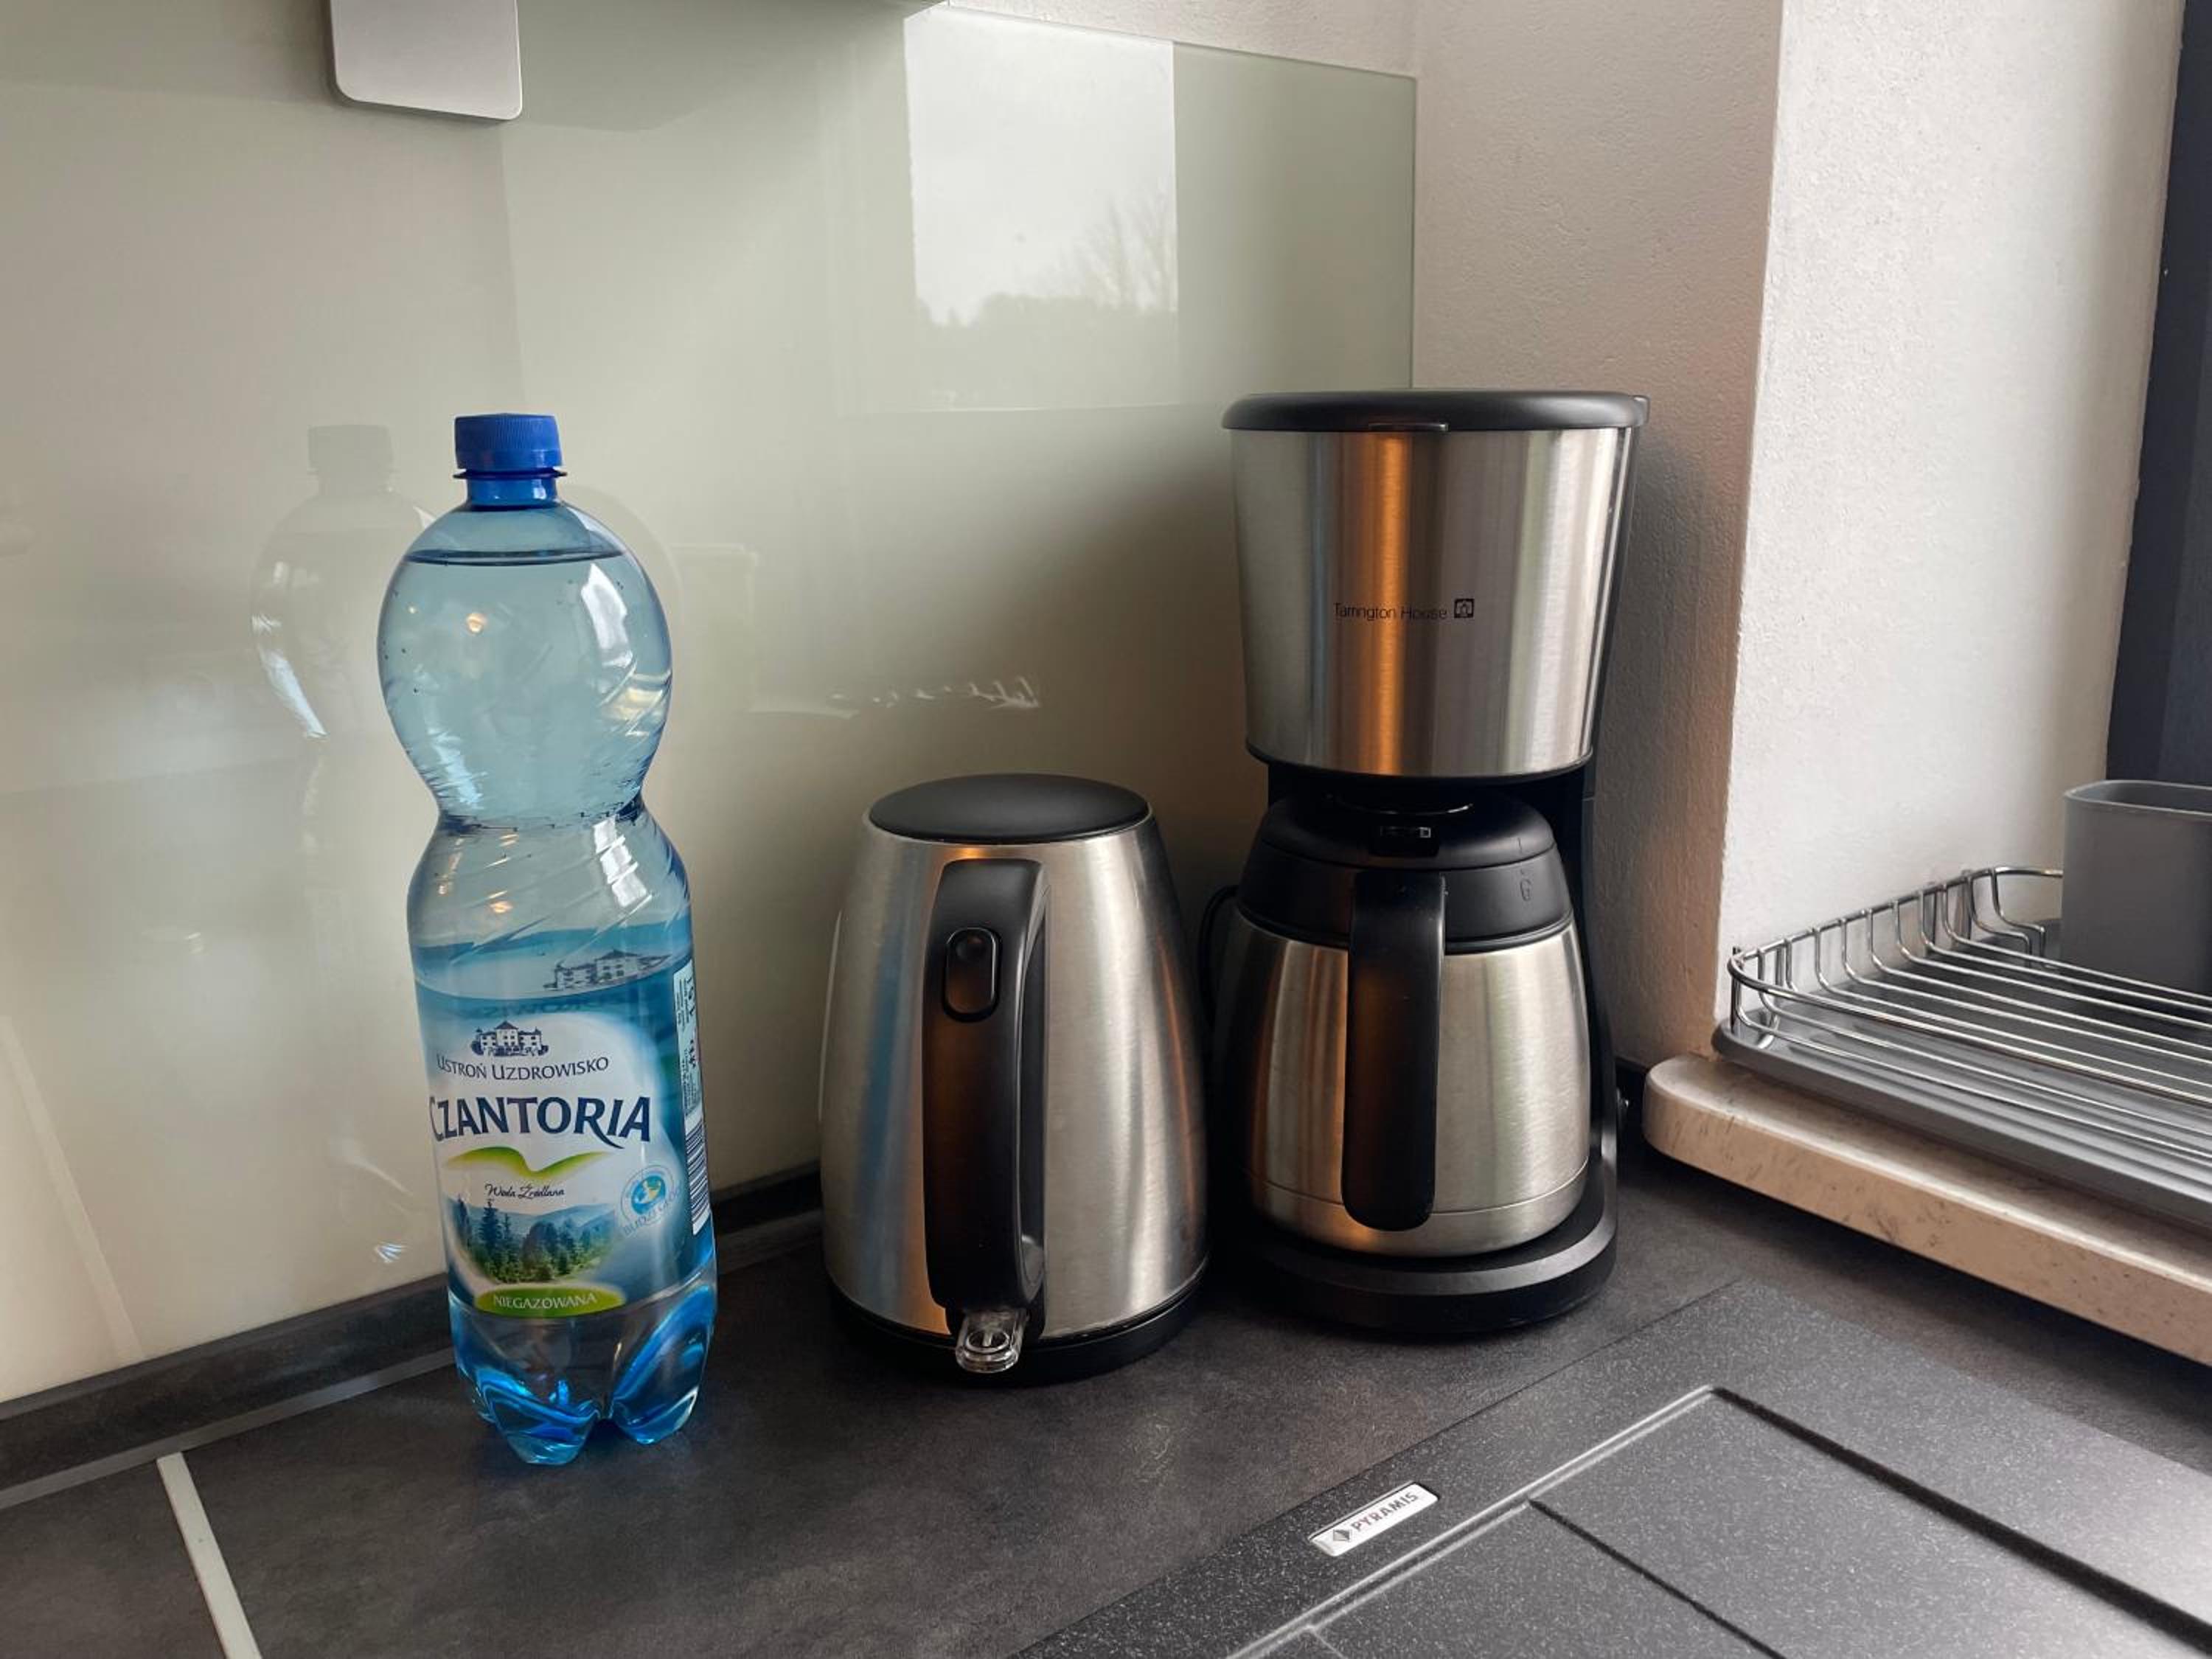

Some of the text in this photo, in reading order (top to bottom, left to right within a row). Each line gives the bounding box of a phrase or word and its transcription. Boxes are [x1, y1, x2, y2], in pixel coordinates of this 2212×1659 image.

[1333, 602, 1396, 621] Tarrington
[437, 1053, 609, 1081] USTROŃ UZDROWISKO
[429, 1096, 651, 1150] CZANTORIA
[493, 1292, 597, 1310] NIEGAZOWANA
[1351, 1492, 1419, 1531] PYRAMIS
